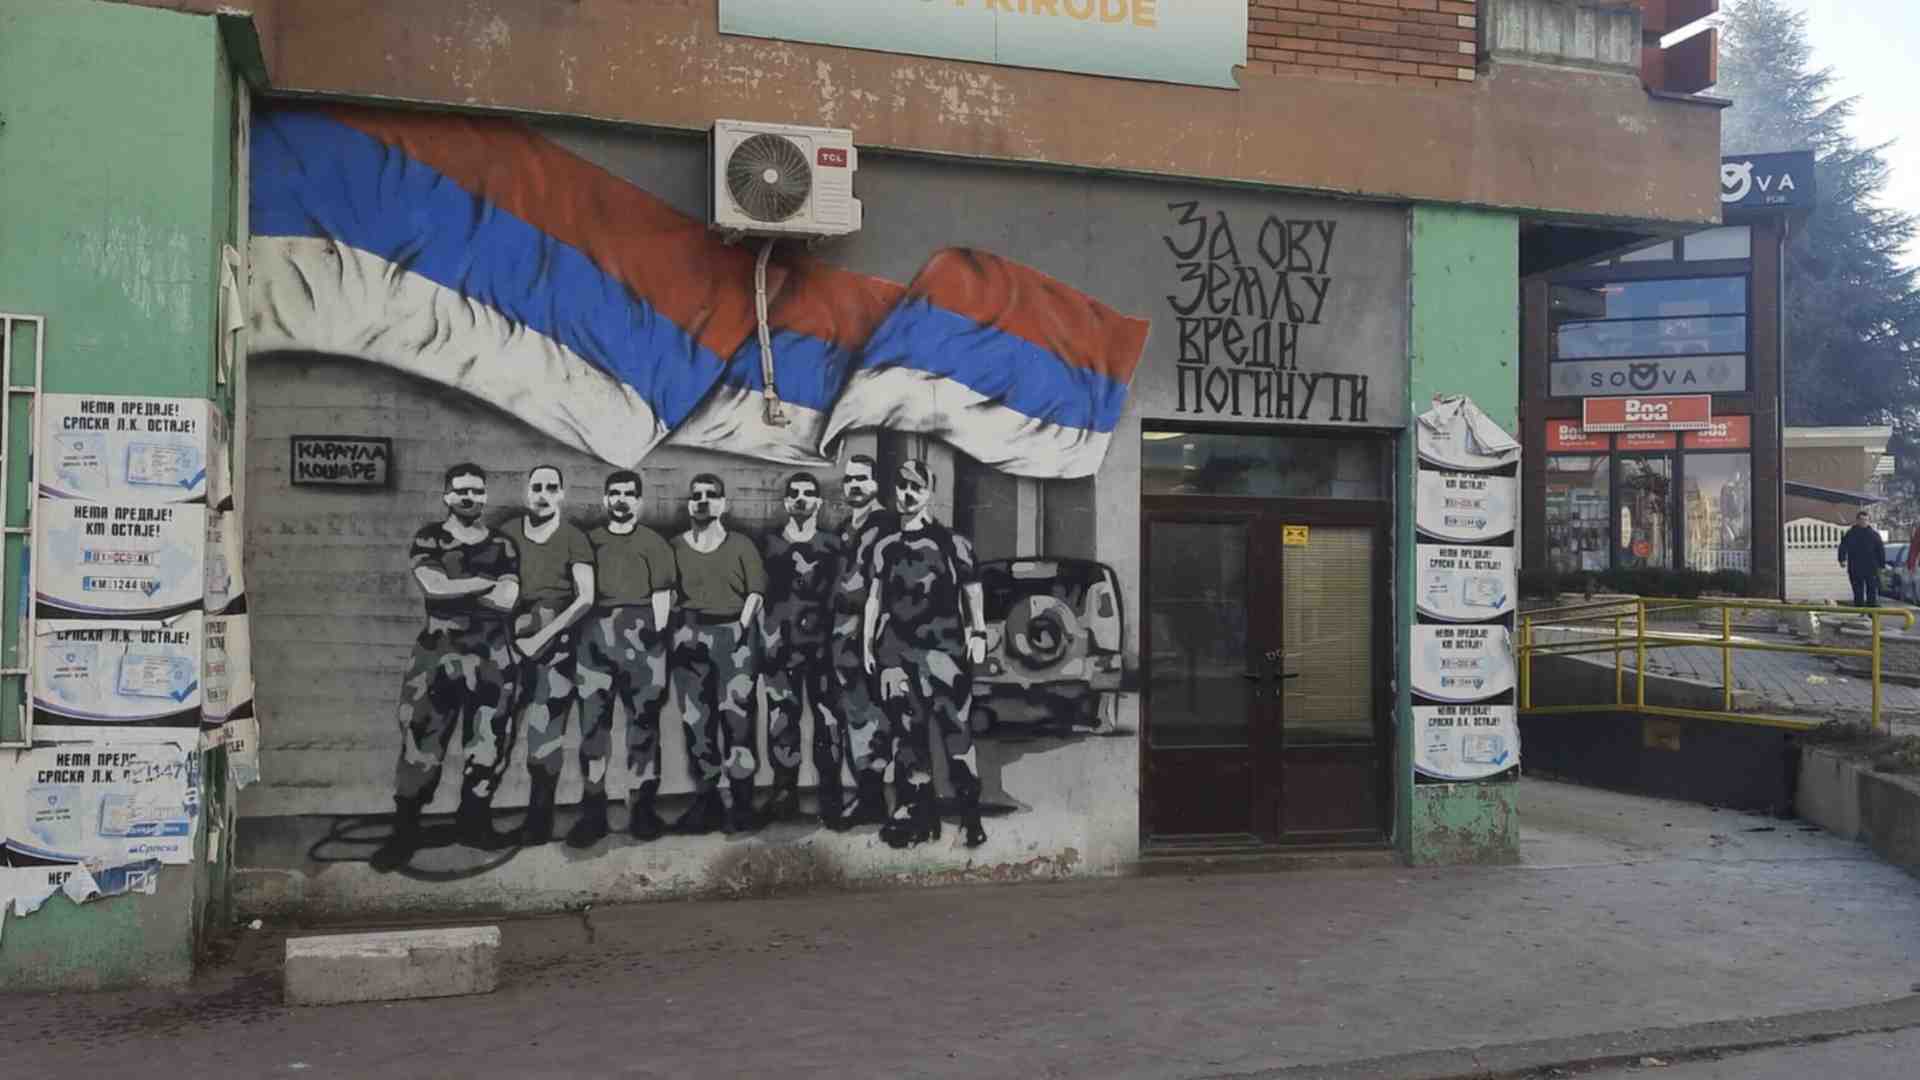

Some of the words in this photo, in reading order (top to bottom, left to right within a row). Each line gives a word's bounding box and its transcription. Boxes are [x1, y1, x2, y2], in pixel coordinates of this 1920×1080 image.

[953, 0, 1158, 27] IRODE
[822, 153, 843, 162] TCL
[1162, 200, 1241, 264] ЗА
[1257, 215, 1337, 274] ОВУ
[1176, 365, 1369, 422] ПОГИНУТИ
[81, 400, 115, 415] НЕМА
[122, 401, 180, 417] ПРЕДАЈЕ!
[63, 416, 109, 430] СРПСКА
[147, 419, 196, 433] ОСТАЈЕ!
[298, 442, 385, 461] КАРАУЛА
[298, 461, 377, 480] КОШАРЕ
[74, 505, 109, 520] НЕМА
[114, 507, 173, 522] ПРЕДАЈЕ!
[86, 523, 105, 536] КМ
[111, 524, 161, 538] ОСТАЈЕ!
[57, 630, 103, 642] СРПСКА
[141, 630, 190, 645] ОСТАЈЕ!
[56, 754, 91, 767] НЕМА
[38, 769, 85, 783] СРПСКА
